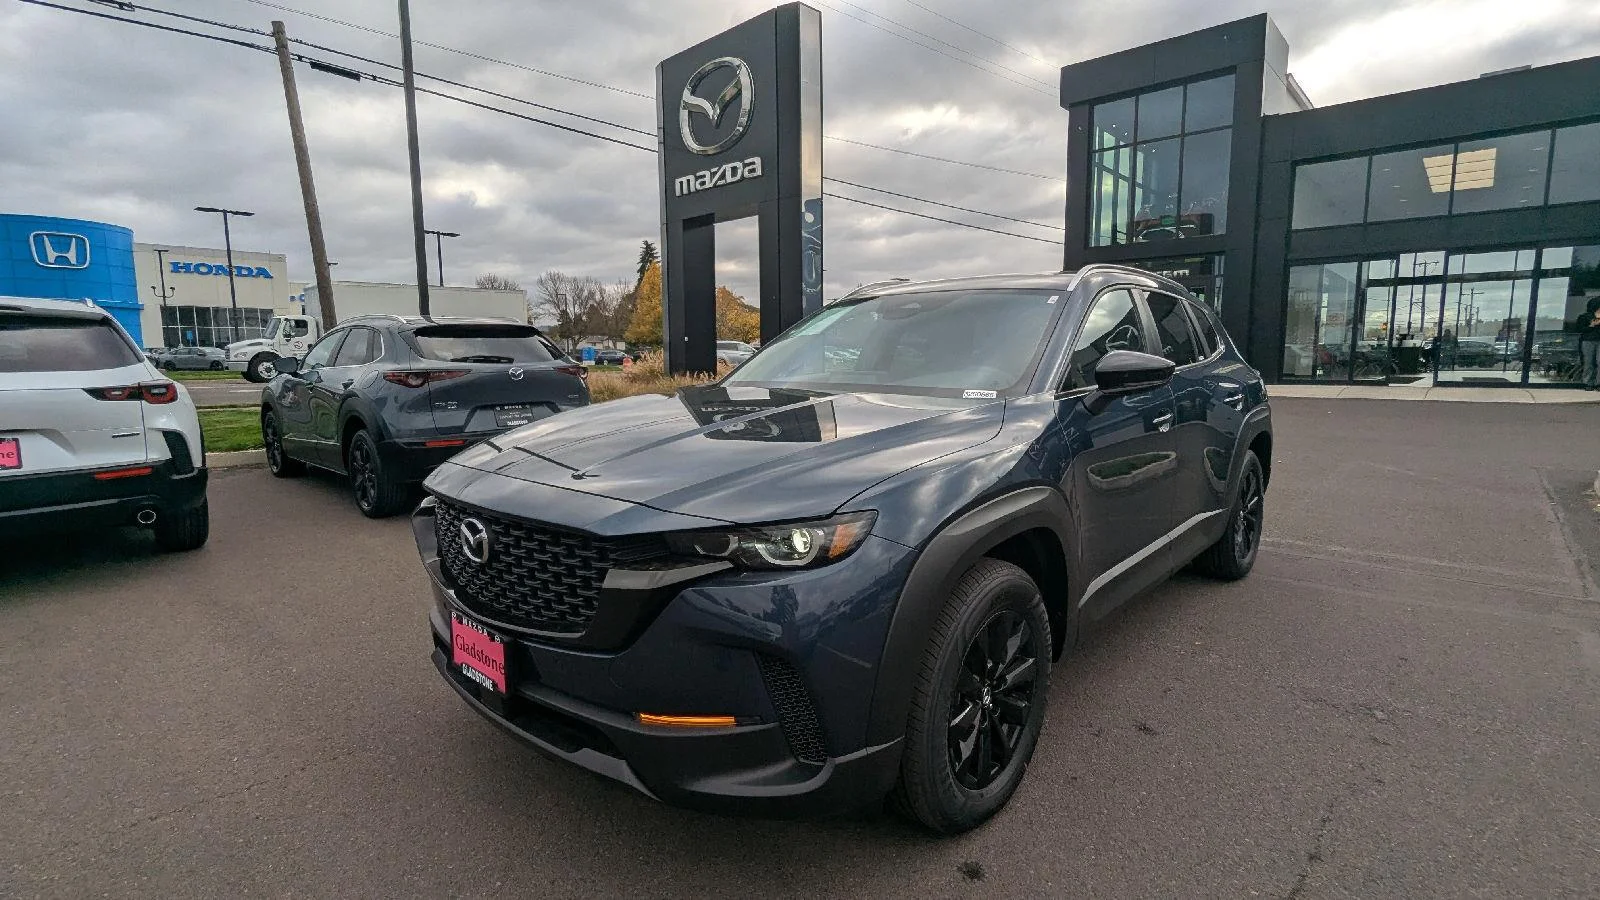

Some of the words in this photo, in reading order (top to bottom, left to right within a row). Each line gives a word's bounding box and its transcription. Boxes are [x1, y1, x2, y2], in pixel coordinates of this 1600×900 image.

[169, 261, 274, 279] HONDA
[455, 634, 505, 675] Gladstone
[462, 663, 494, 692] GLADSTONE
